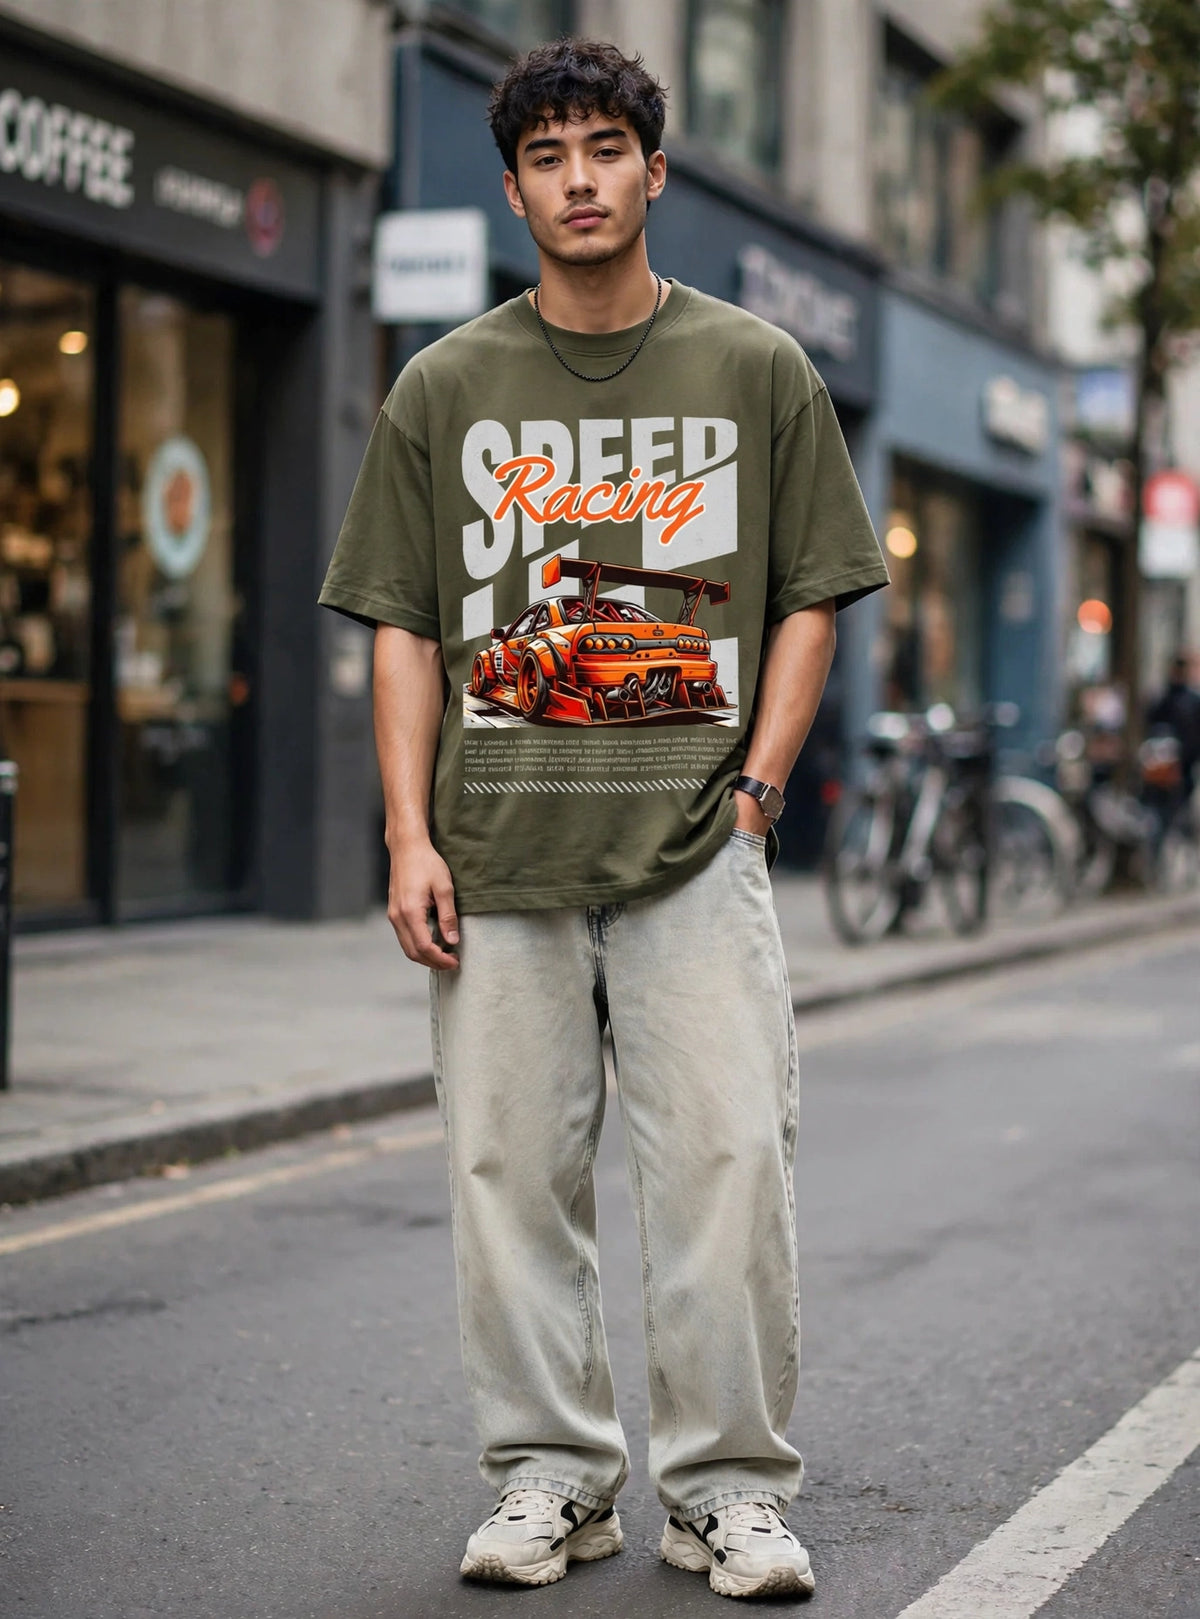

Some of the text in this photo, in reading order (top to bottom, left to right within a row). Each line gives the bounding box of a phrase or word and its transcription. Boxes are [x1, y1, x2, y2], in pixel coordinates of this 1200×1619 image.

[0, 88, 135, 208] COFFEE
[462, 417, 738, 580] SPEED
[493, 454, 706, 546] Racing
